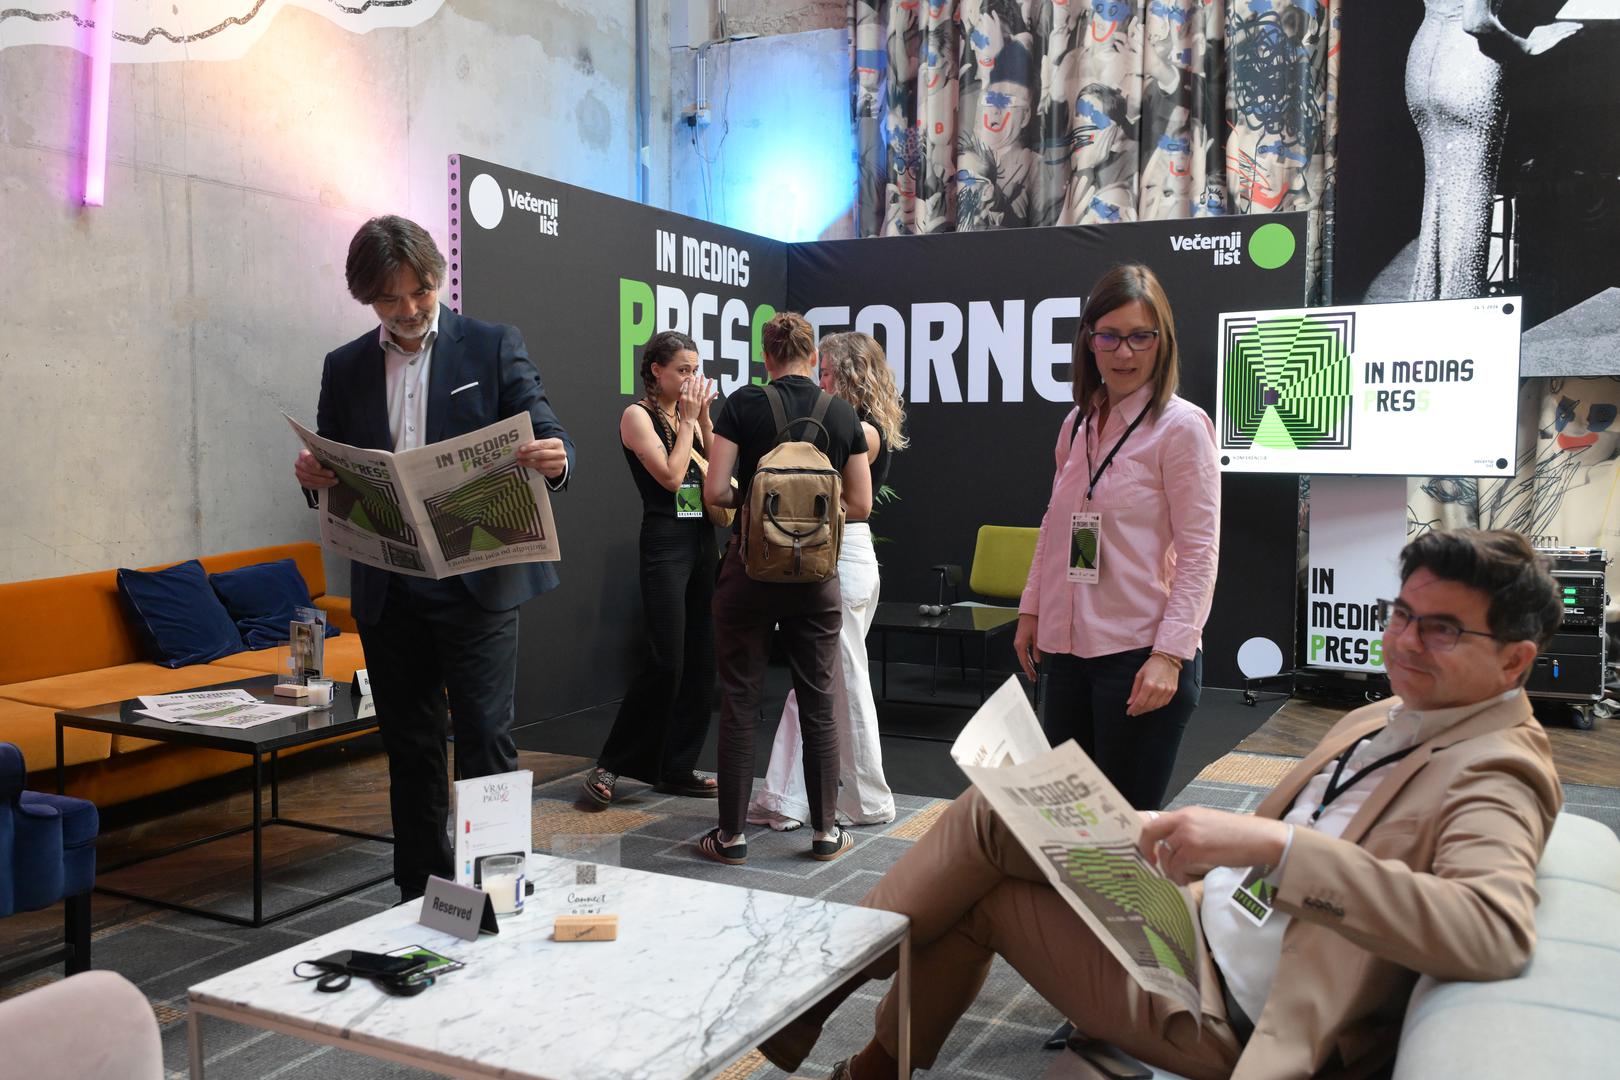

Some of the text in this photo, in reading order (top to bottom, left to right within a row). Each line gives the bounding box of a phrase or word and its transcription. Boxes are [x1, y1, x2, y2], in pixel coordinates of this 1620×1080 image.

[507, 188, 558, 220] Večernji
[540, 215, 559, 236] list
[1169, 231, 1242, 251] Večernji
[656, 229, 750, 288] IN MEDIAS
[1213, 249, 1241, 266] list
[803, 296, 1090, 403] ORNE
[1364, 358, 1474, 384] IN MEDIAS
[434, 428, 519, 469] IN MEDIAS
[462, 444, 513, 473] PRESS
[351, 462, 391, 480] PRESS
[1312, 567, 1334, 594] IN
[1311, 601, 1385, 632] MEDIA
[1563, 607, 1585, 615] SC
[1311, 634, 1385, 667] PRESS
[1039, 802, 1099, 828] PRESS
[432, 896, 473, 921] Reserved
